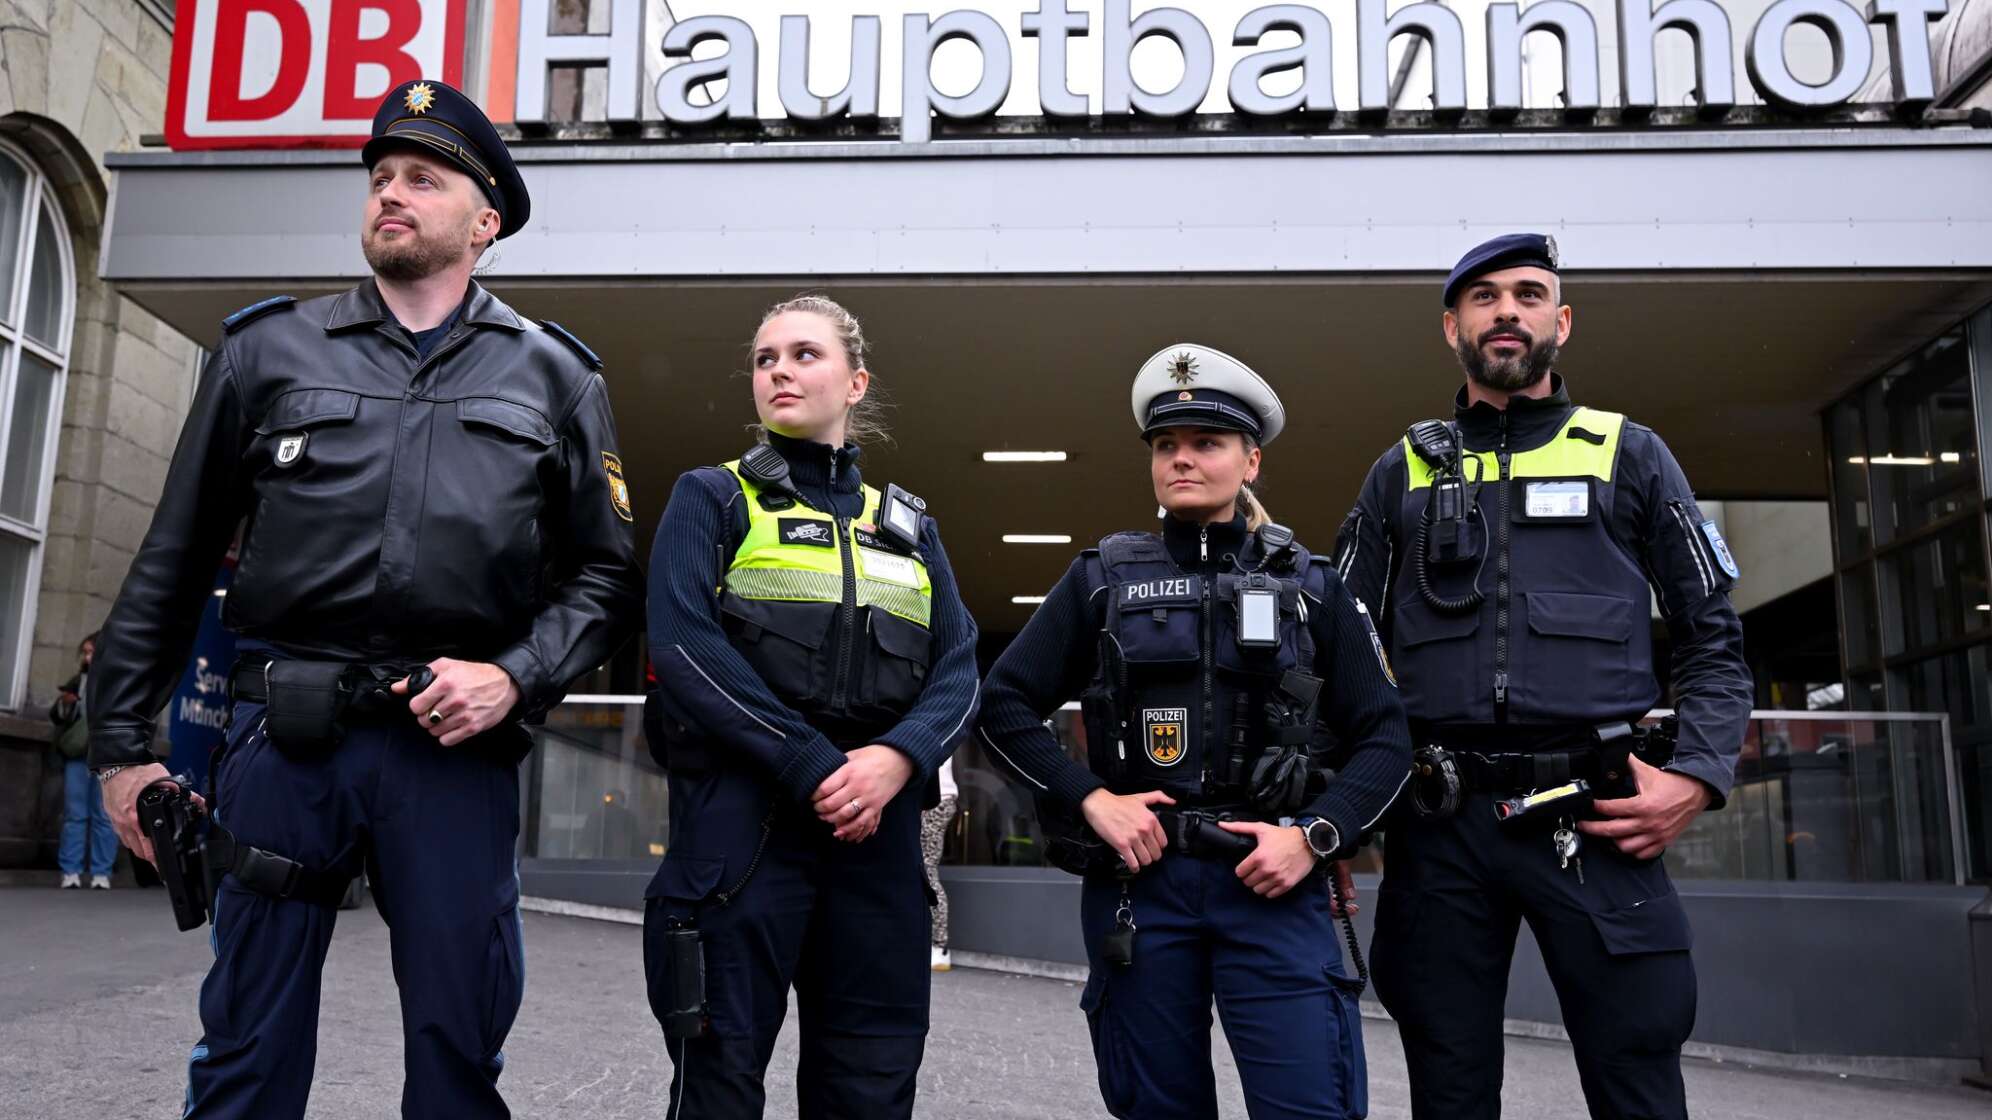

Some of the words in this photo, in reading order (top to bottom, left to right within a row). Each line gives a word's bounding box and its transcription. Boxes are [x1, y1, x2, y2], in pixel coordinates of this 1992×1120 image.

[206, 0, 423, 122] DB
[514, 0, 1949, 143] Hauptbahnhof
[856, 532, 873, 544] DB
[1127, 578, 1191, 600] POLIZEI
[1146, 710, 1184, 722] POLIZEI
